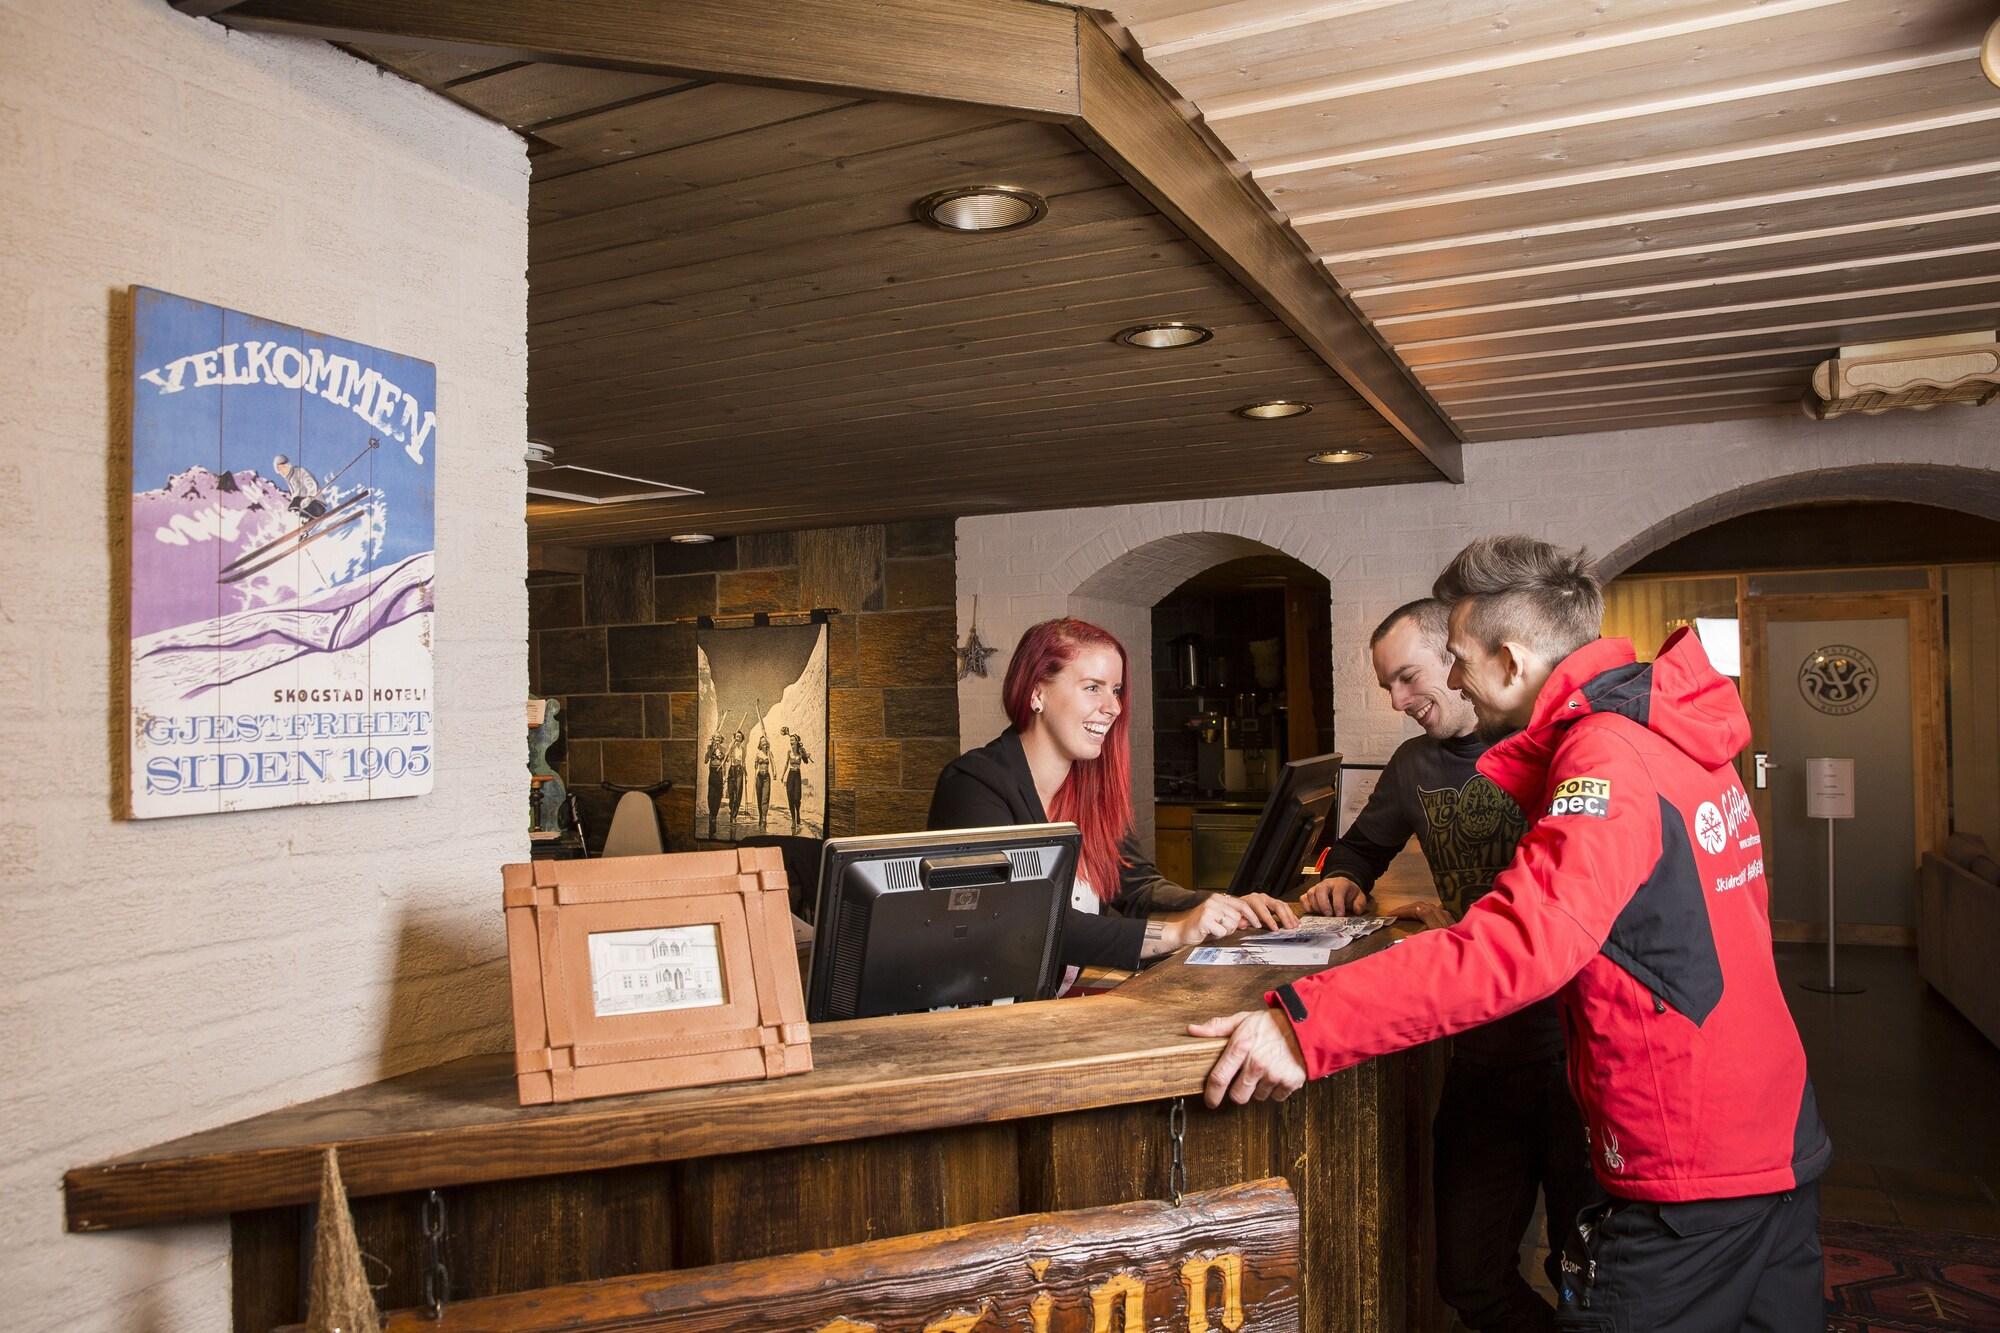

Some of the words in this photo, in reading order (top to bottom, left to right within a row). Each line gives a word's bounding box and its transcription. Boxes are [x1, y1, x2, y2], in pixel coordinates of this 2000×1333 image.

[139, 341, 436, 465] VELKOMMEN
[274, 688, 364, 703] SKOGSTAD
[144, 711, 433, 745] GJESTFRIHET
[146, 748, 334, 796] SIDEN
[343, 745, 432, 782] 1905
[1549, 796, 1605, 817] pec.
